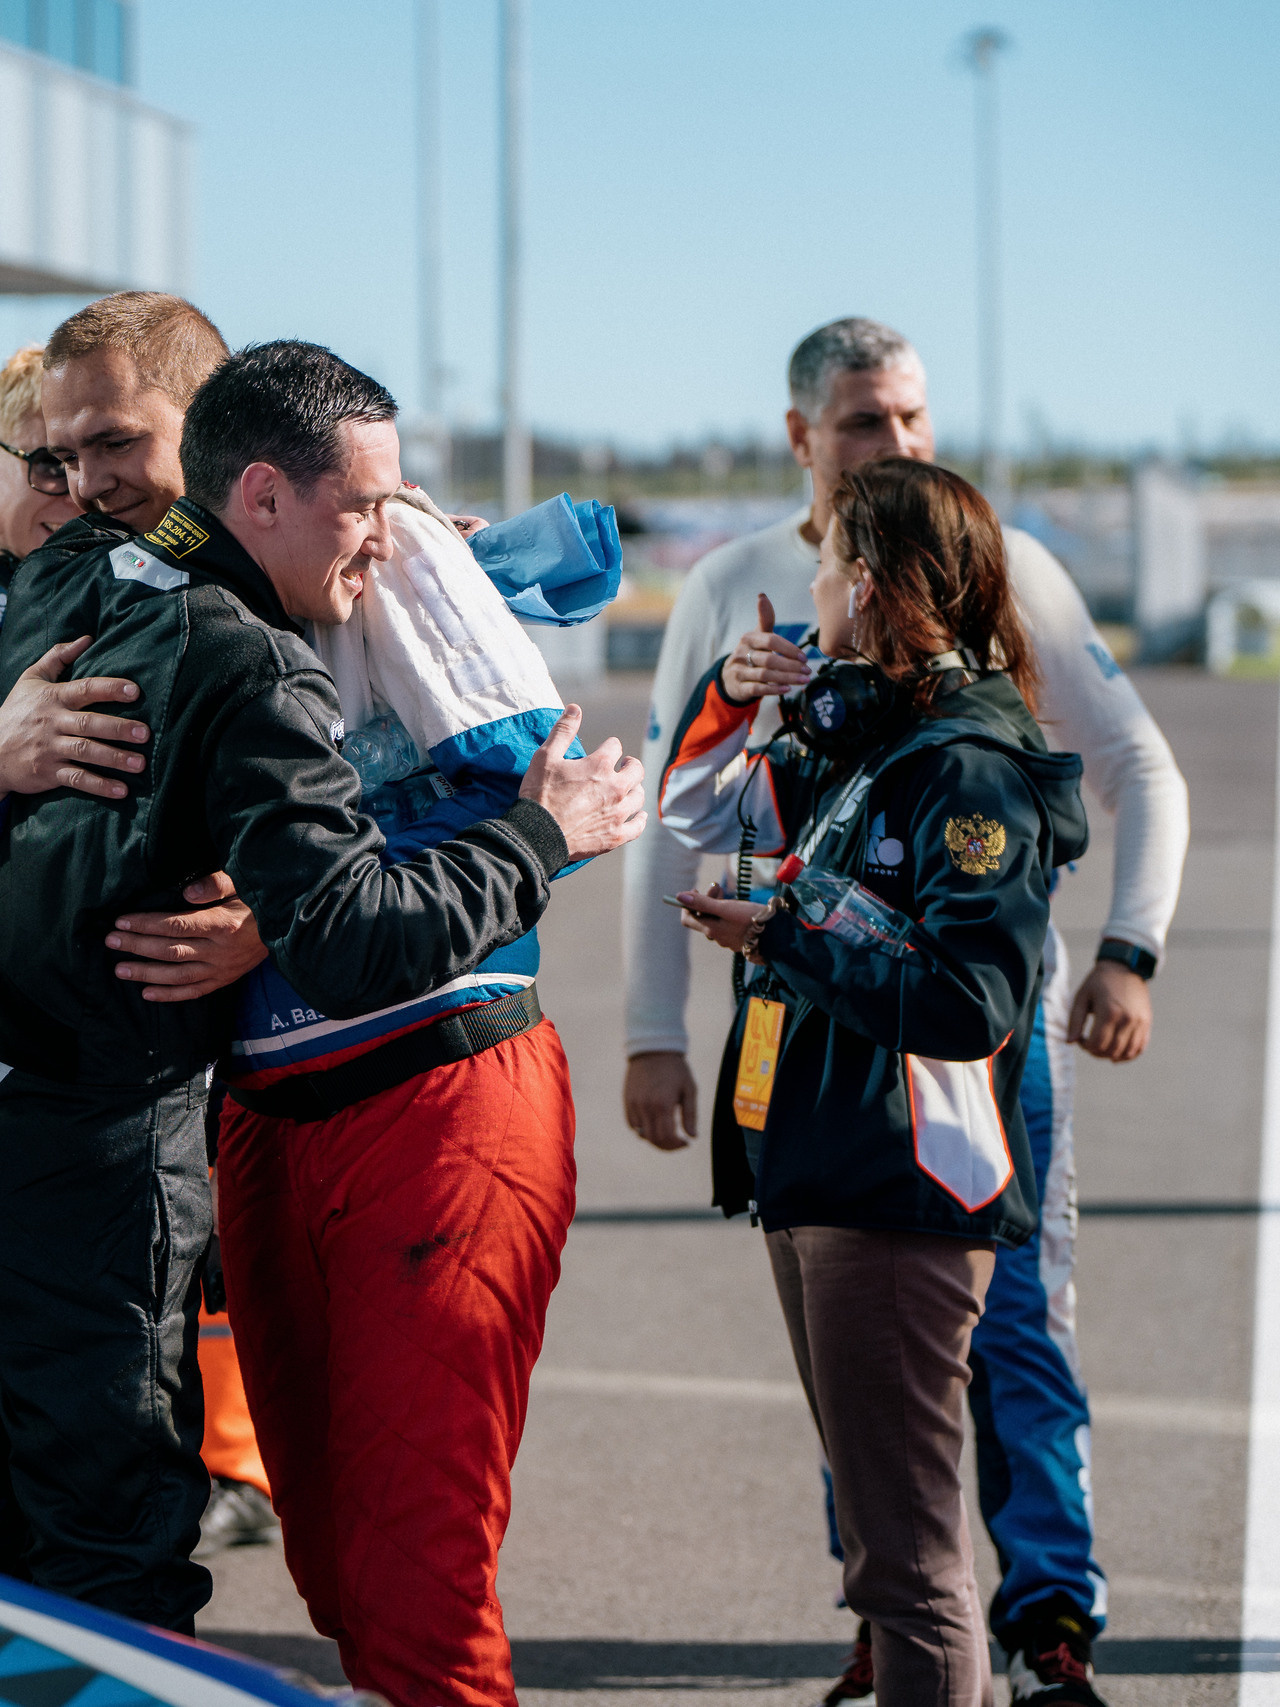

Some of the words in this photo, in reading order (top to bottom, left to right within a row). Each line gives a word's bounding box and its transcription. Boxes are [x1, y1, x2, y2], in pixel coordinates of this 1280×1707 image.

[868, 867, 899, 877] SPORT
[271, 1013, 290, 1030] A.
[291, 1008, 325, 1024] Ba
